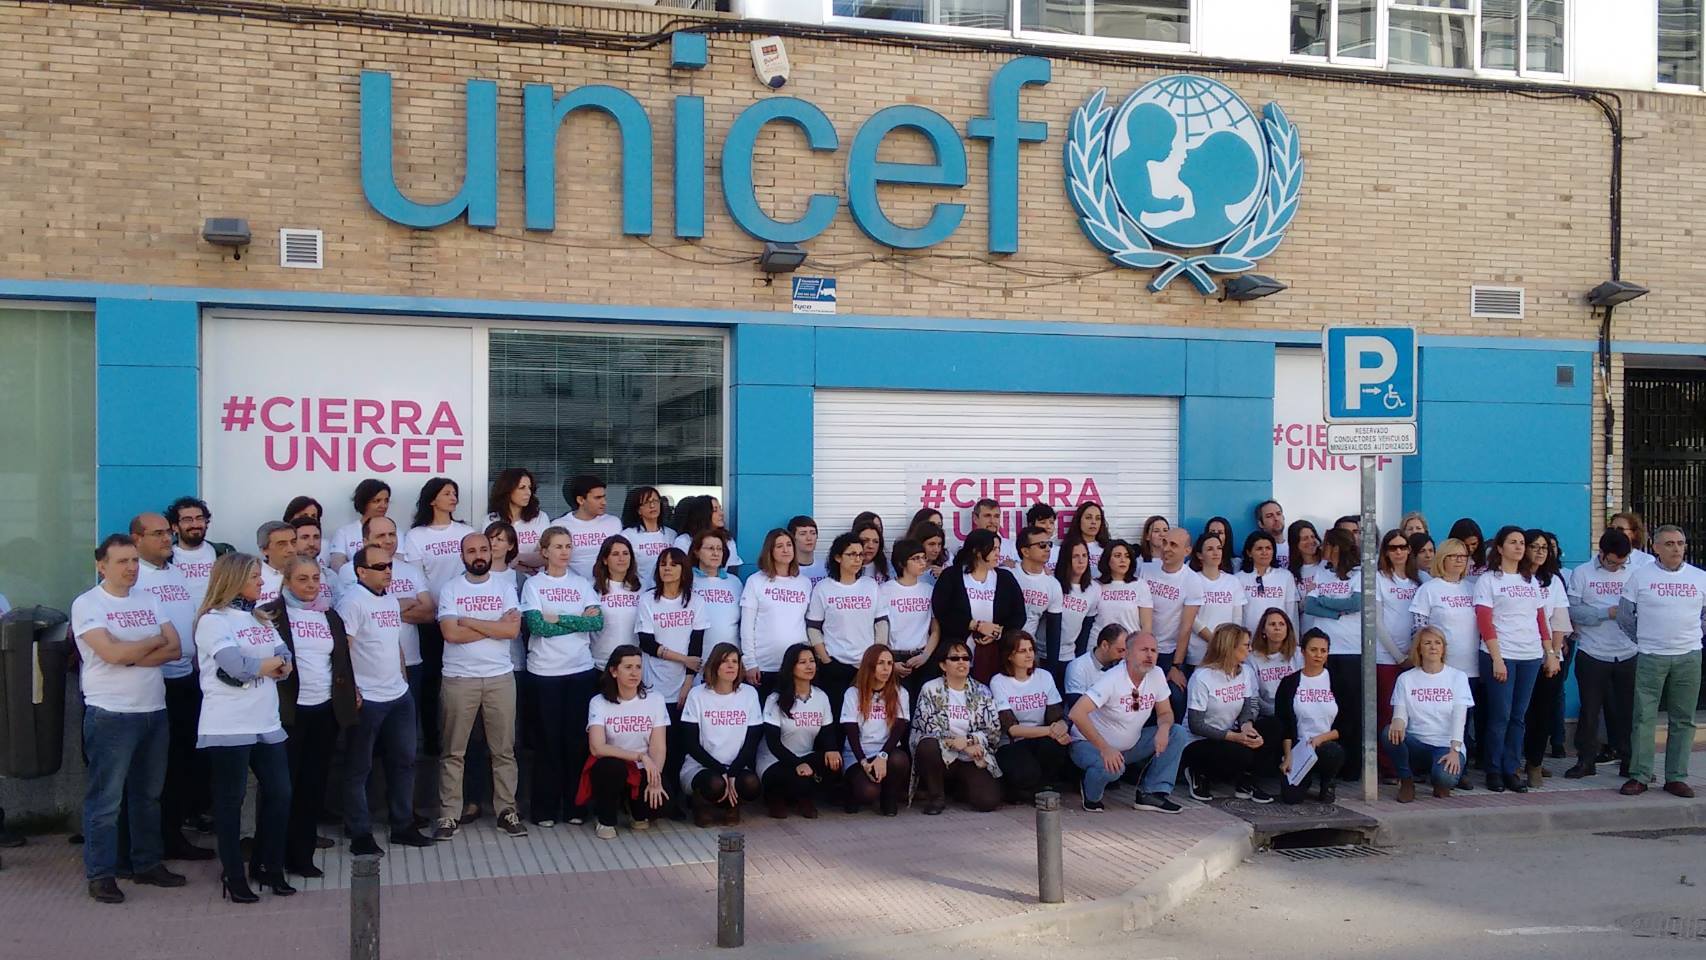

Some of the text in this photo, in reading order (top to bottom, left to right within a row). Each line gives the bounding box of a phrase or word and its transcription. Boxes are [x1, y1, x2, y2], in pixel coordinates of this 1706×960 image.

[360, 32, 1050, 254] unicef
[1345, 336, 1398, 410] P
[221, 396, 464, 435] #CIERRA
[1273, 424, 1327, 446] #CIE
[264, 436, 464, 473] UNICEF
[1287, 448, 1392, 471] UNICF
[920, 478, 1104, 508] #CIERRA
[573, 533, 607, 541] CIERRA
[426, 540, 461, 550] #CIERR
[433, 548, 461, 556] UNICE
[176, 563, 212, 571] #CIERR
[765, 588, 805, 597] #CIERRA
[1022, 590, 1048, 599] IERRA
[457, 596, 502, 605] #CIERRA
[891, 598, 930, 606] #CIERRA
[1024, 598, 1048, 606] NICEF
[1063, 602, 1086, 612] NICEF
[106, 610, 154, 620] #CIERRA
[654, 610, 694, 621] #CIERRA
[378, 619, 400, 628] UNICE
[298, 630, 332, 639] UNICE
[1263, 674, 1284, 682] UNIC
[1411, 688, 1453, 696] #CIERRA
[1008, 692, 1048, 704] #CIERRA
[1120, 693, 1154, 704] #CRRA
[1125, 702, 1154, 712] UCEF
[704, 710, 746, 719] #CIERRA
[606, 716, 652, 725] #CIERRA
[614, 724, 653, 733] UNICEF
